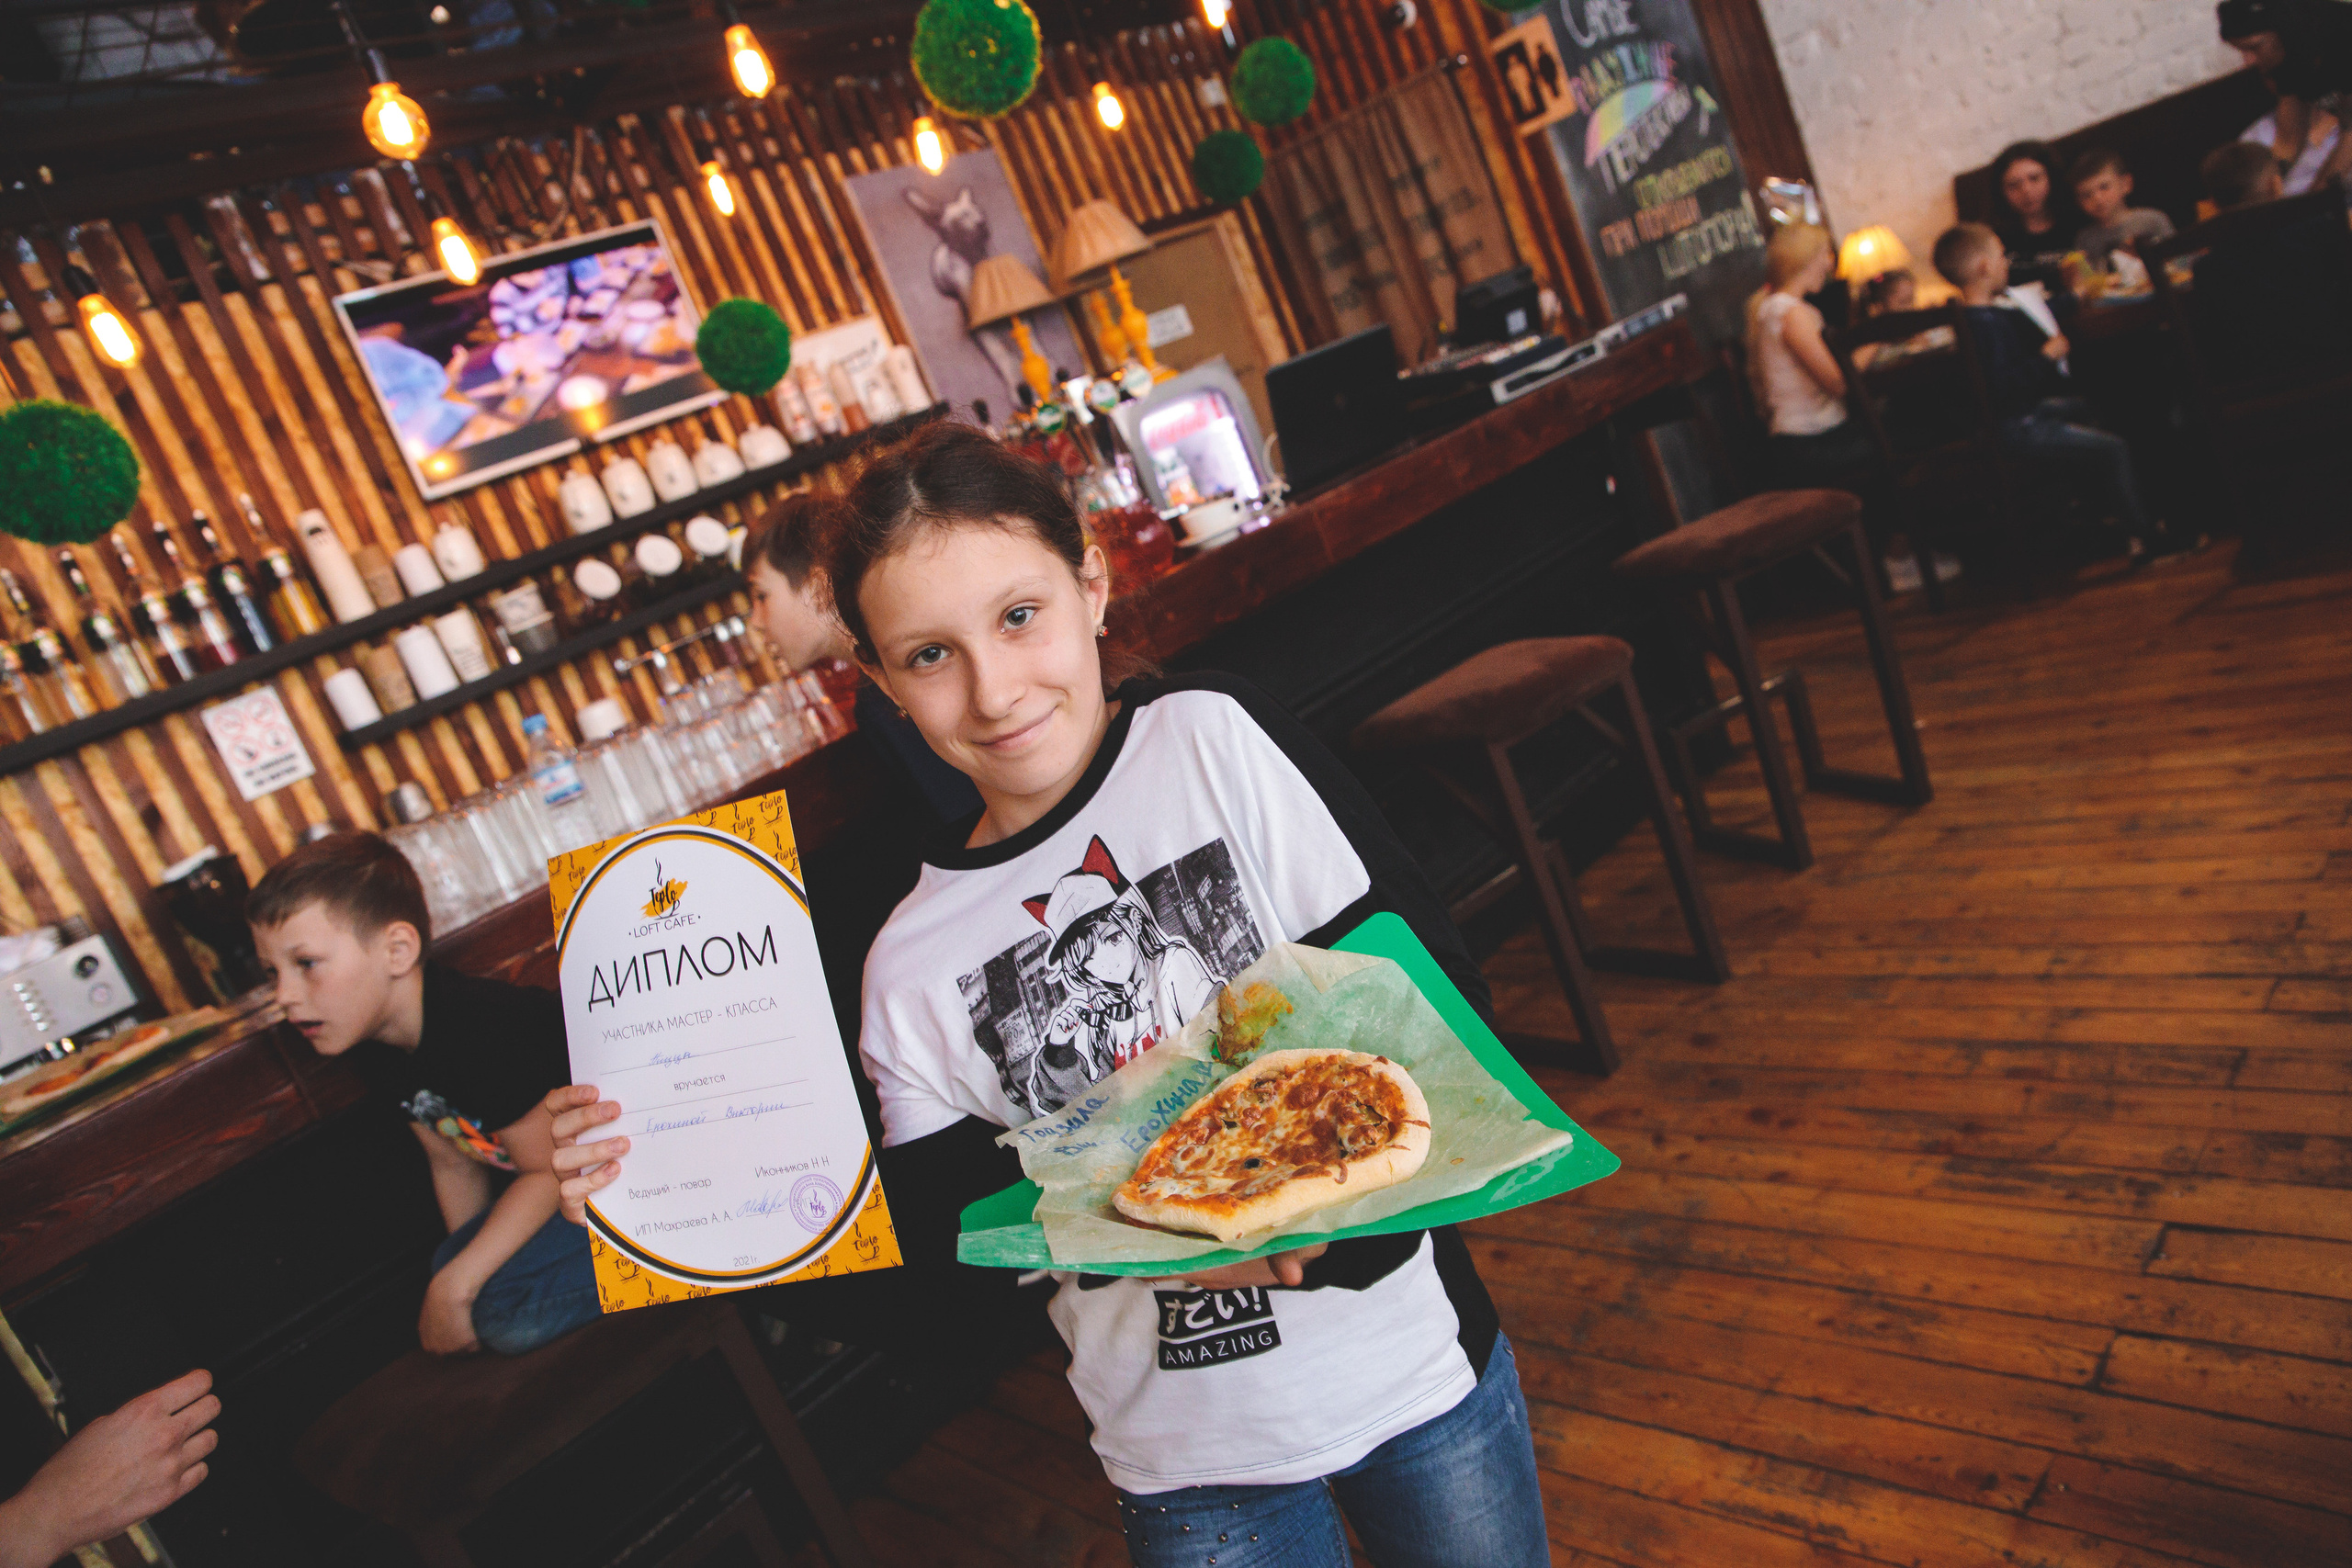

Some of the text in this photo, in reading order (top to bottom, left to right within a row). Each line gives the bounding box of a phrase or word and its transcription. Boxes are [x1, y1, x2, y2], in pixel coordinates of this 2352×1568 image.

[649, 880, 678, 912] Teplo
[633, 913, 695, 938] LOFT CAFE
[588, 924, 778, 1013] ДИПЛОМ
[602, 1018, 665, 1043] УЧАСТНИКА
[666, 1009, 714, 1032] МАСТЕР
[724, 996, 778, 1019] КЛАССА
[673, 1073, 726, 1092] вручается
[754, 1156, 831, 1179] Иконников Н Н
[628, 1184, 671, 1200] Ведущий
[680, 1179, 712, 1190] повар
[635, 1211, 733, 1236] ИП Махраева А. А.
[732, 1255, 761, 1268] 2021г.
[1165, 1330, 1273, 1365] AMAZING
